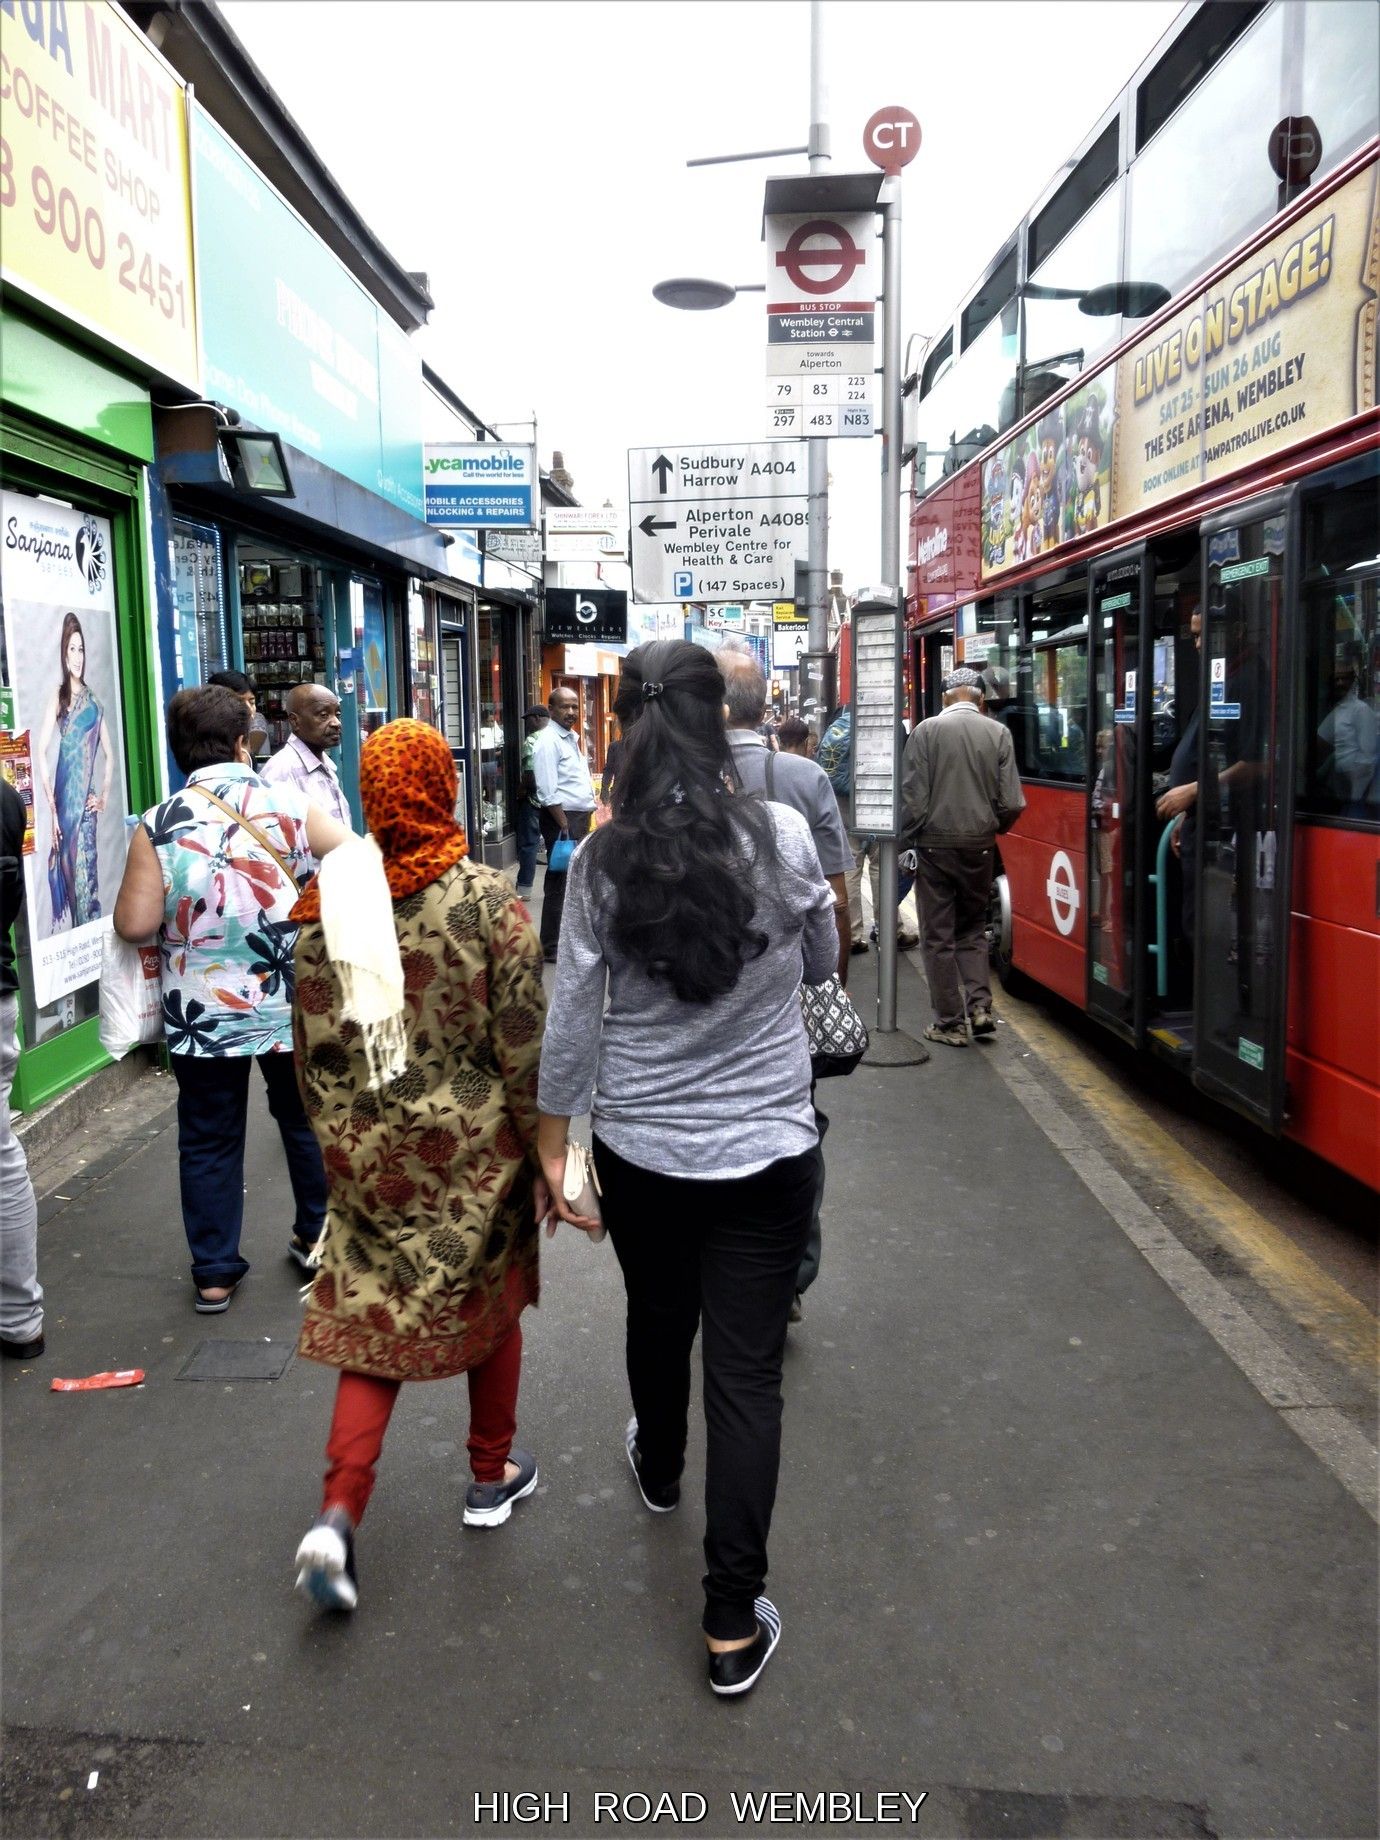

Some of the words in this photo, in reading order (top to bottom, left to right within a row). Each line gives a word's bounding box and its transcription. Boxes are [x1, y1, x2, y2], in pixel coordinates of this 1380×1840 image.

[0, 0, 73, 77] GA
[84, 2, 172, 173] MART
[872, 122, 913, 150] CT
[104, 147, 160, 224] SHOP
[31, 165, 106, 270] 900
[118, 232, 186, 329] 2451
[1134, 329, 1182, 408] LIVE
[1185, 297, 1225, 372] ON
[1228, 213, 1335, 346] STAGE!
[780, 318, 824, 328] Wembley
[828, 317, 864, 326] Central
[790, 329, 825, 338] Station
[800, 360, 842, 369] Alperton
[848, 378, 865, 386] 223
[1160, 397, 1177, 426] SAT
[1180, 388, 1193, 411] 25
[1204, 365, 1230, 398] SUN
[1233, 354, 1248, 381] 26
[1252, 331, 1281, 372] AUG
[777, 385, 792, 396] 79
[812, 384, 828, 395] 83
[848, 392, 865, 400] 224
[1144, 434, 1164, 462] THE
[1166, 422, 1184, 451] SSE
[1187, 398, 1234, 440] ARENA,
[1236, 352, 1306, 413] WEMBLEY
[774, 416, 794, 426] 297
[810, 414, 832, 426] 483
[844, 414, 870, 425] N83
[425, 455, 524, 474] ycamobile
[680, 456, 744, 471] Sudbury
[751, 461, 796, 476] A404
[684, 474, 738, 487] Harrow
[1143, 473, 1162, 493] BOOK
[1164, 461, 1190, 484] ONLINE
[1190, 455, 1200, 471] AT
[460, 498, 524, 506] ACCESSORIES
[427, 508, 474, 516] NLOCKING
[477, 508, 483, 516] &
[486, 508, 524, 516] REPAIRS
[686, 508, 754, 524] Alperton
[689, 525, 751, 539] Perivale
[6, 516, 74, 563] Sanjana
[664, 542, 720, 554] Wembley
[726, 540, 768, 552] Centre
[774, 538, 791, 550] for
[682, 554, 724, 566] Health
[730, 554, 738, 565] &
[744, 554, 773, 564] Care
[676, 573, 690, 596] P
[732, 577, 785, 593] Spaces)
[550, 625, 622, 633] JEWELLERS
[708, 620, 722, 628] Key
[795, 635, 804, 644] A
